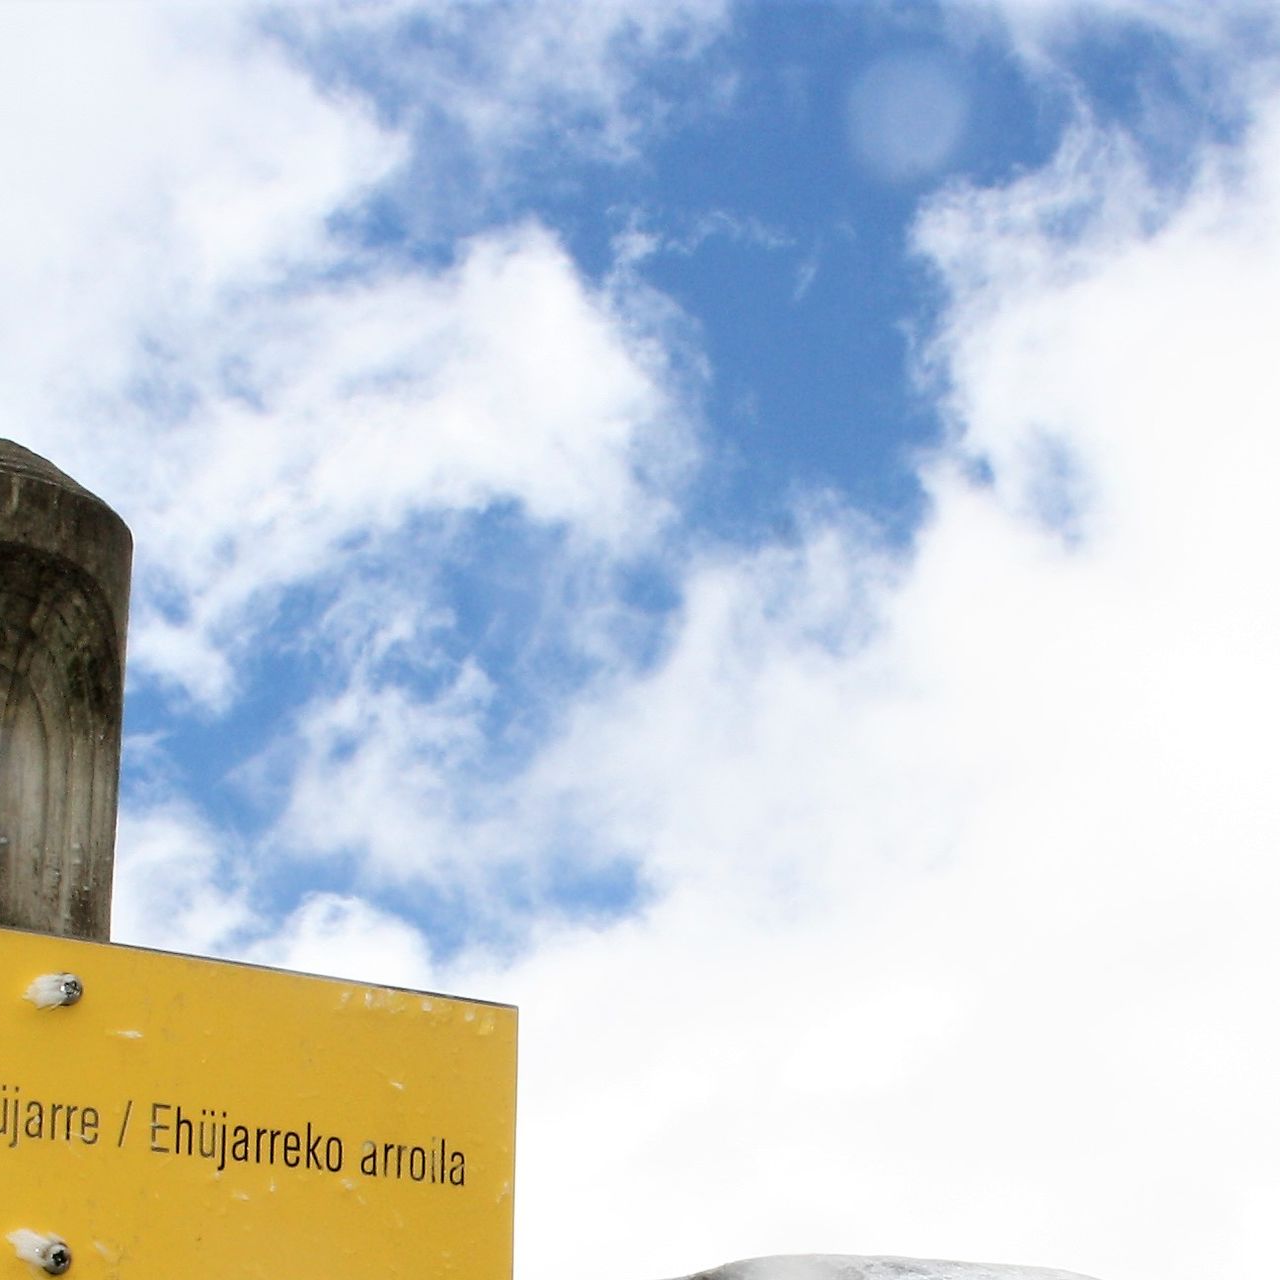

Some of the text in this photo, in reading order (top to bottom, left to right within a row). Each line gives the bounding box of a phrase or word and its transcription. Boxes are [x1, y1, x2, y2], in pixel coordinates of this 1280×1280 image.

[116, 1099, 134, 1149] /
[150, 1102, 344, 1174] Ehüjarreko
[360, 1137, 467, 1188] arroila
